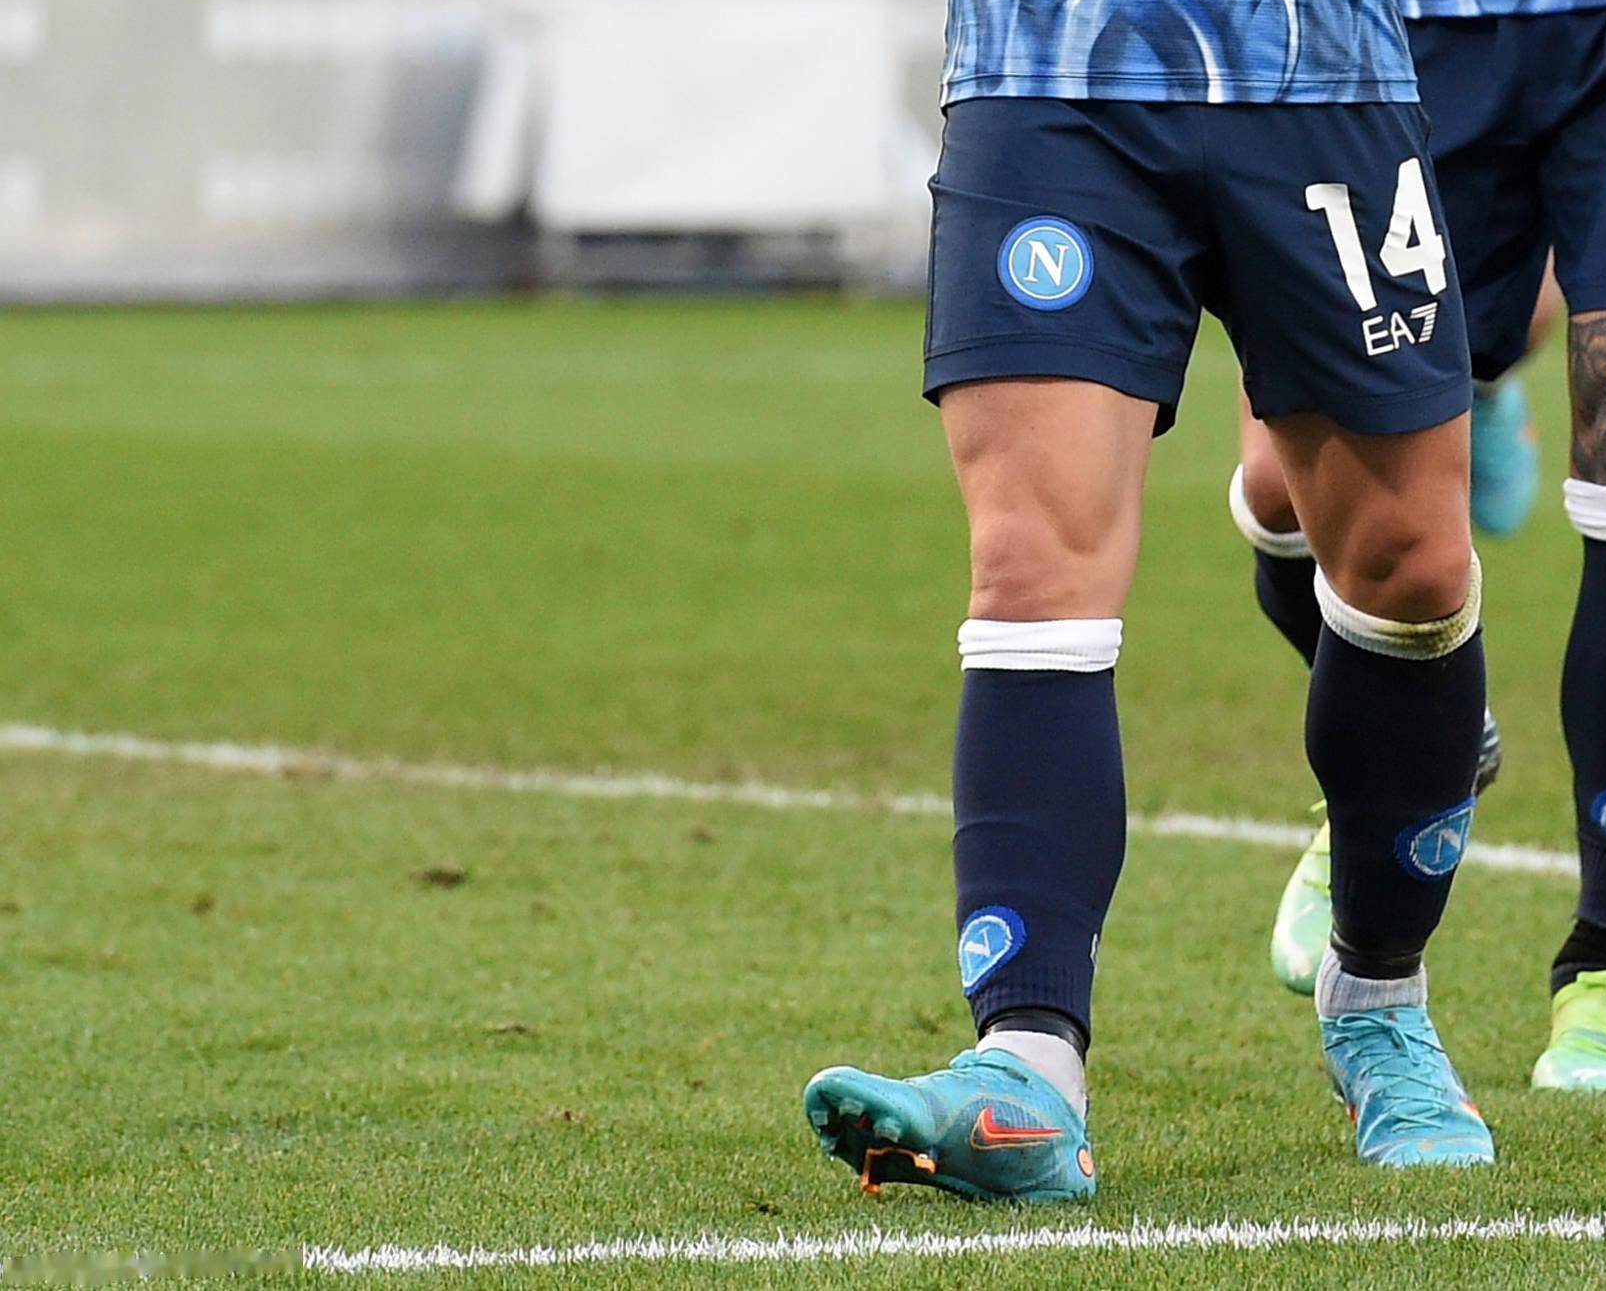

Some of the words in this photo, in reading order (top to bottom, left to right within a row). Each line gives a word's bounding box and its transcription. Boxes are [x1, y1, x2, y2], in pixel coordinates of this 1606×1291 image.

[1304, 156, 1448, 313] 14
[1023, 240, 1069, 287] N
[1361, 301, 1439, 357] EA7
